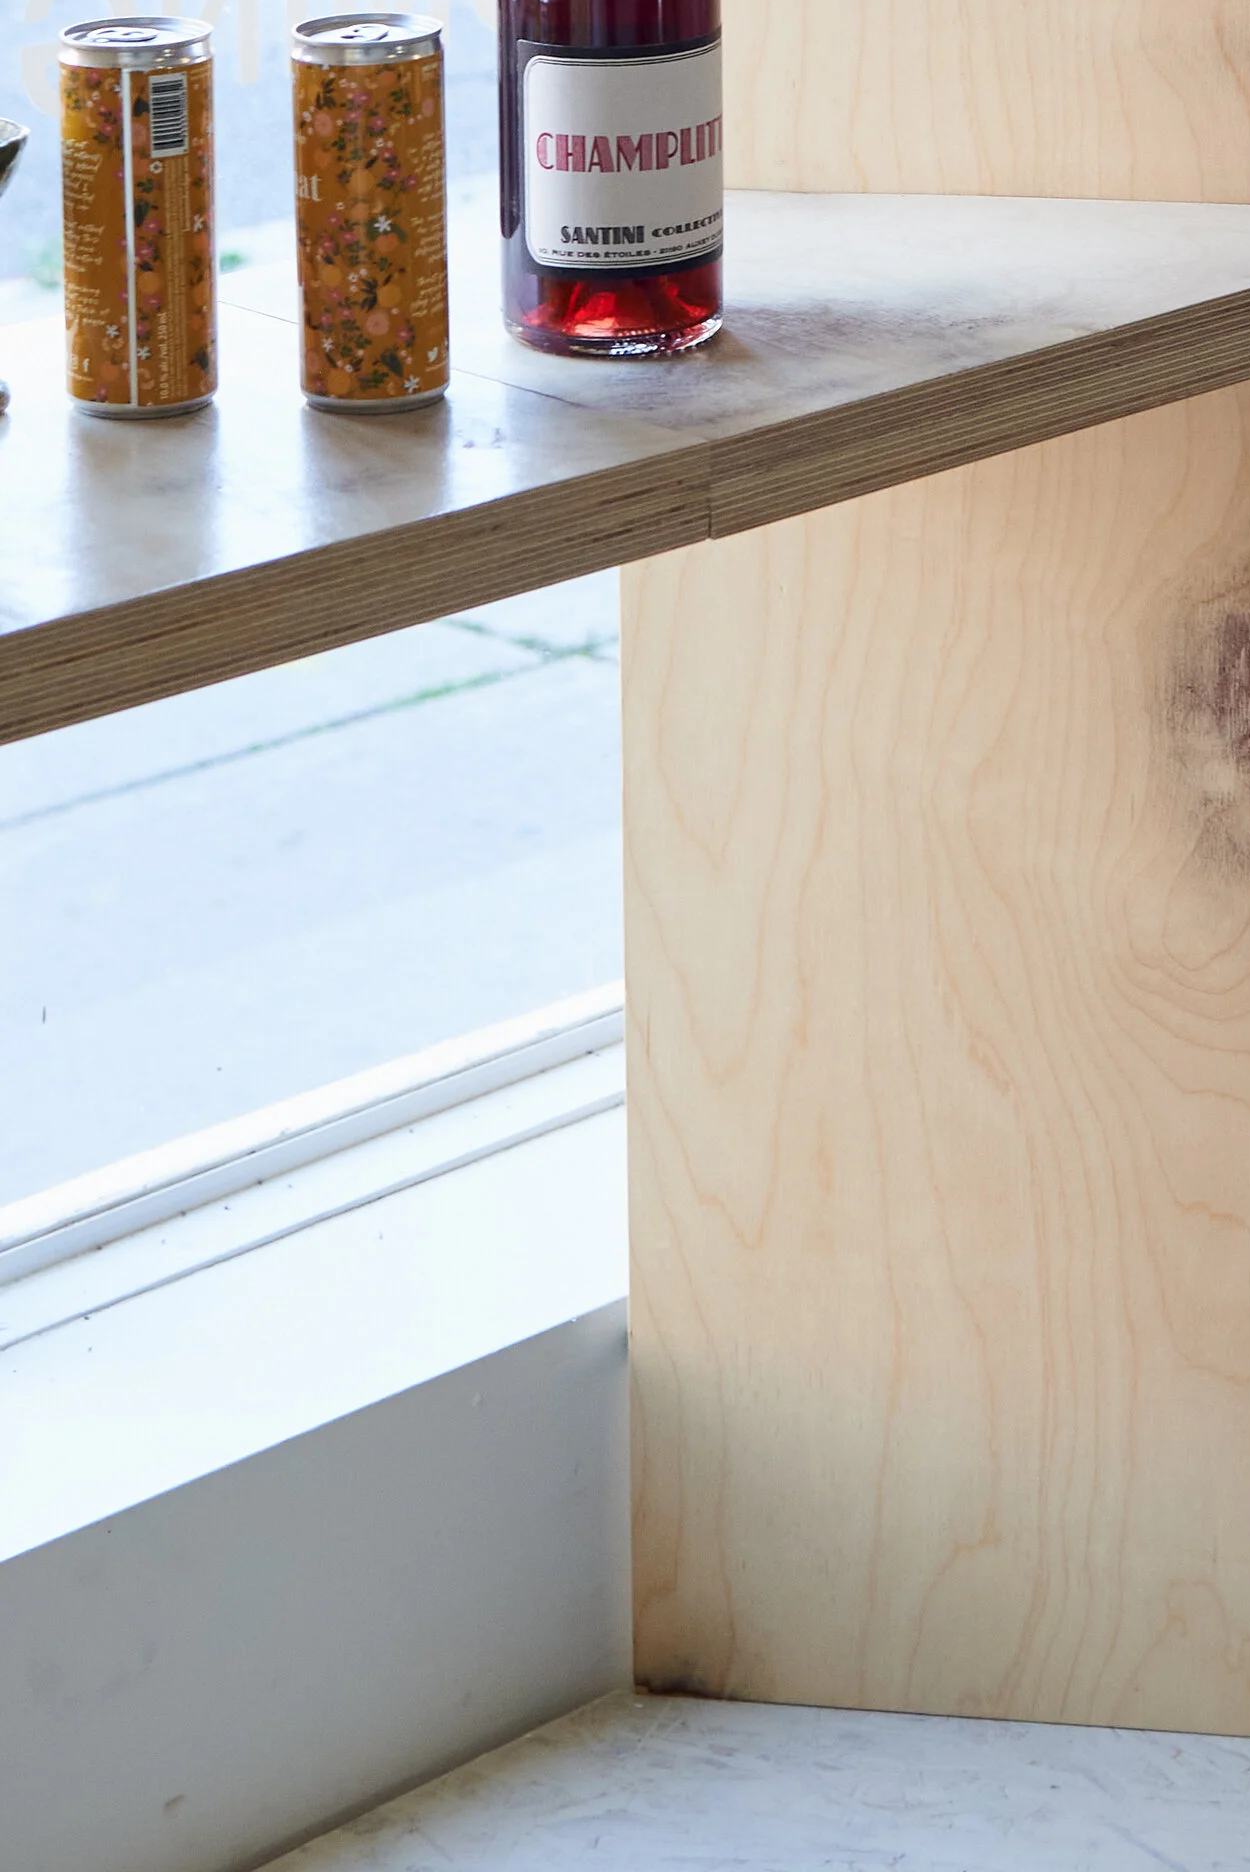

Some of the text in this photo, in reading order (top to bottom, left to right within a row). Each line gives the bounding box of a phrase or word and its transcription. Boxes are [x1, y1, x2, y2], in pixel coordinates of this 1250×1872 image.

[560, 225, 645, 246] SANTINI
[552, 249, 573, 257] RUE
[604, 248, 651, 258] ÉTOILES
